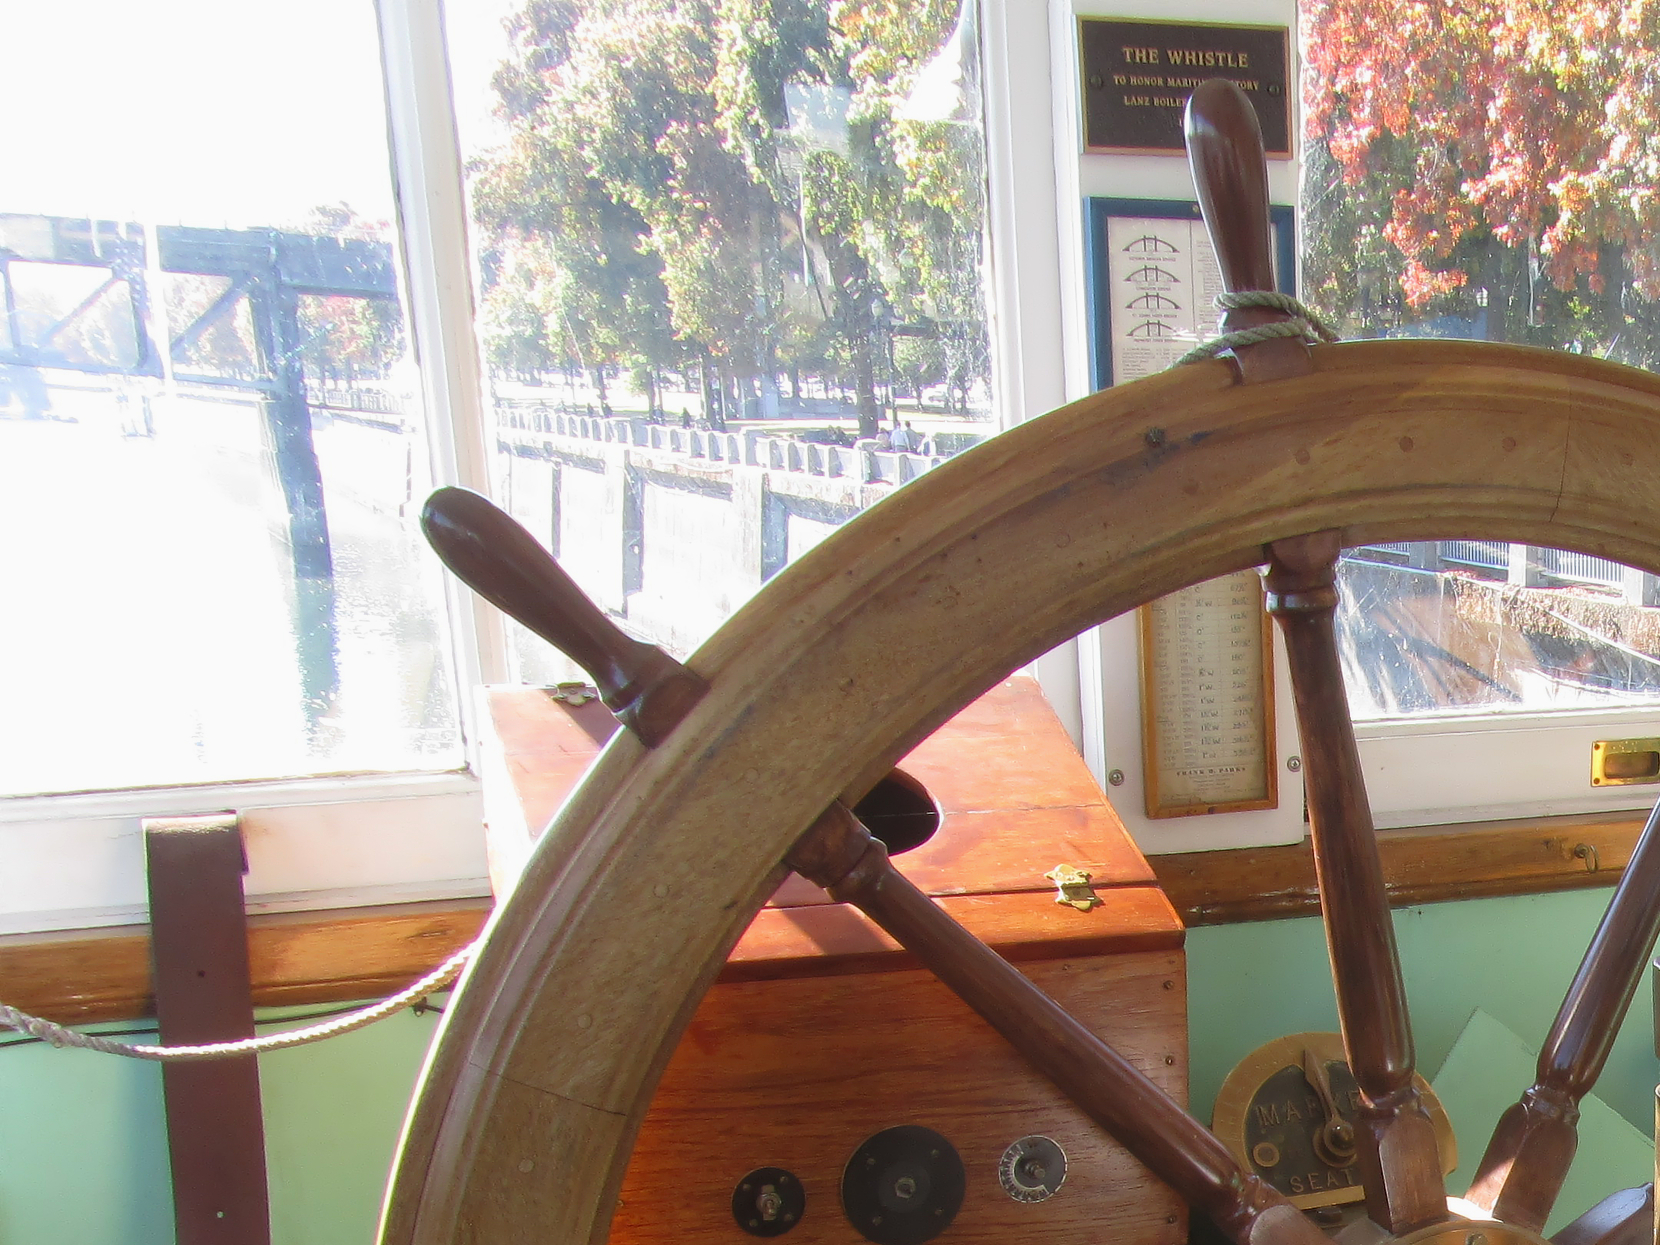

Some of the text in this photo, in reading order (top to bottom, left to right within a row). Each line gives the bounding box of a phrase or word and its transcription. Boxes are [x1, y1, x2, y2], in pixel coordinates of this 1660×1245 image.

[1122, 47, 1250, 69] THE WHISTLE
[1113, 75, 1127, 86] TO
[1130, 76, 1164, 87] HONOR
[1167, 77, 1205, 88] MARITI
[1124, 95, 1151, 107] LANZ
